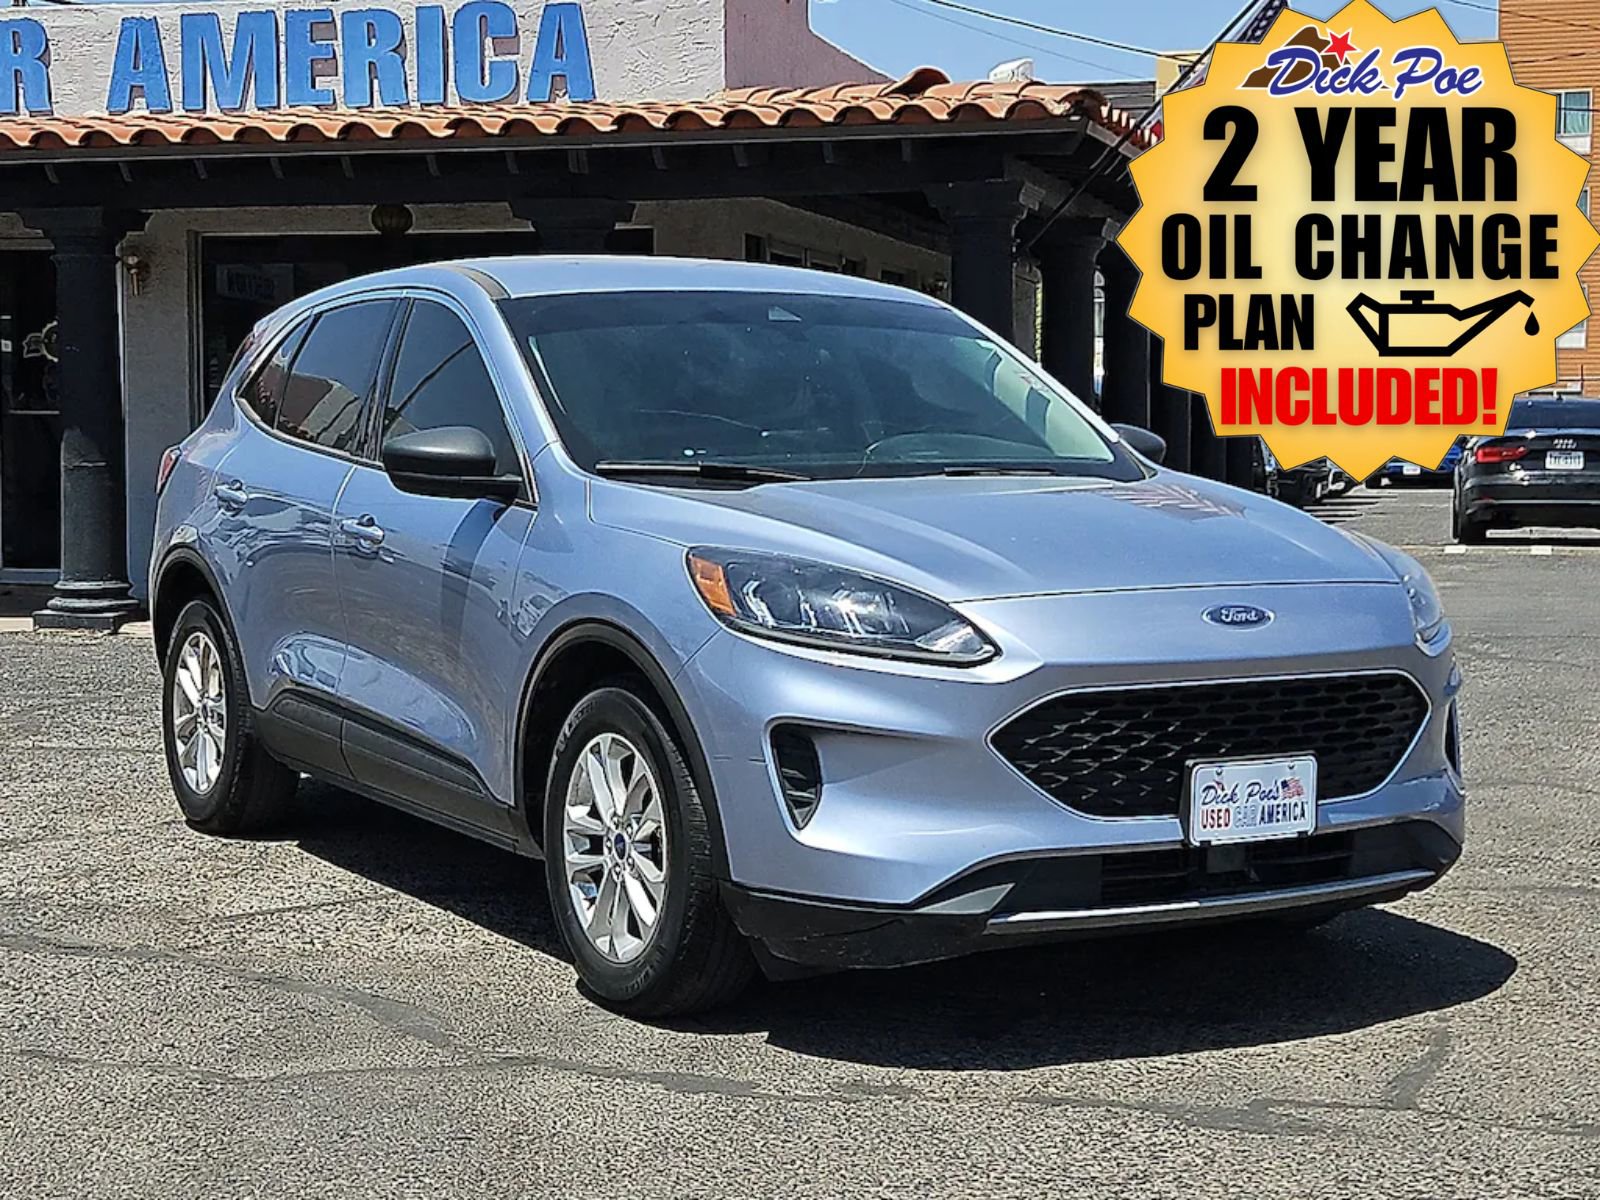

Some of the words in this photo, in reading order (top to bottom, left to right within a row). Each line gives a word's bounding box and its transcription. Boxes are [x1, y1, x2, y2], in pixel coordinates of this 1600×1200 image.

[107, 1, 596, 113] AMERICA
[1221, 607, 1259, 622] Ford
[1201, 807, 1231, 829] USED
[1259, 801, 1306, 825] AMERICA
